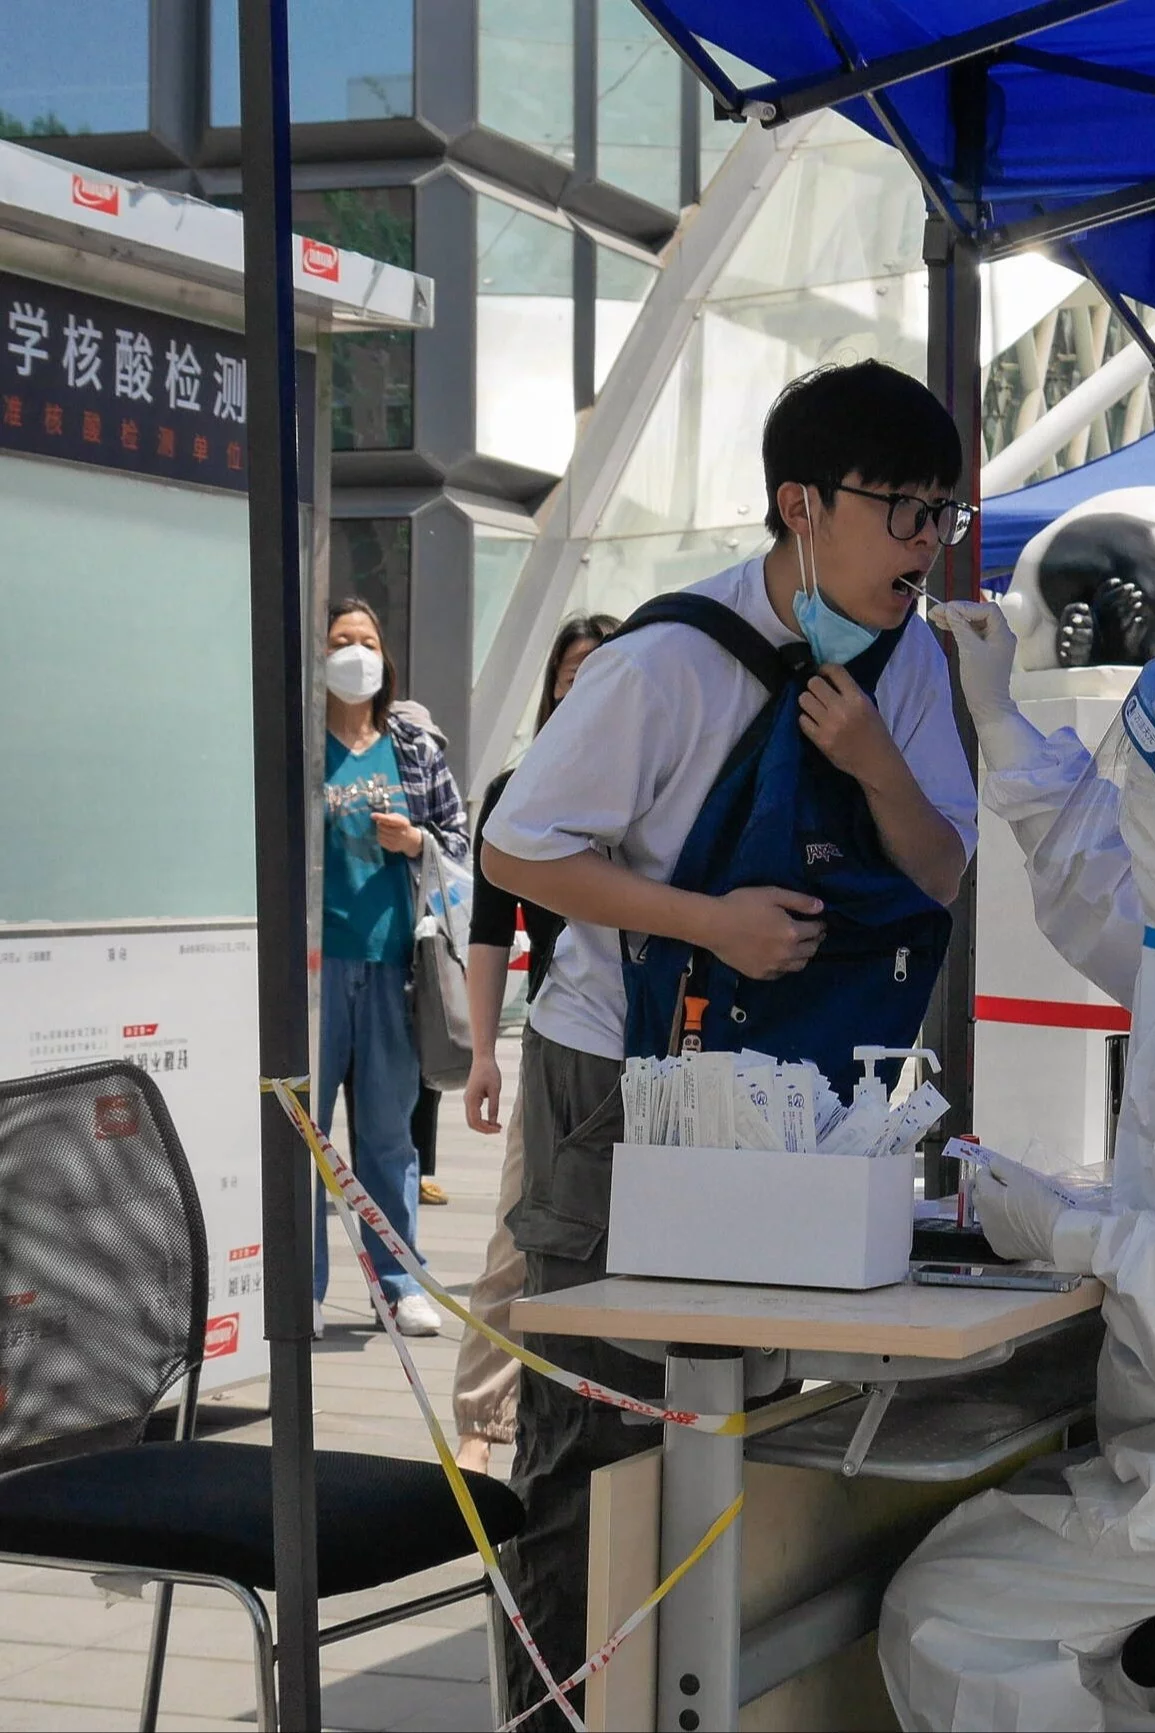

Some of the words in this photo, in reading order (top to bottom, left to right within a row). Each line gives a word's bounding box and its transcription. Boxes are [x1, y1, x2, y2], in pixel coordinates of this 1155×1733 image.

[8, 302, 247, 424] 学核酸检测
